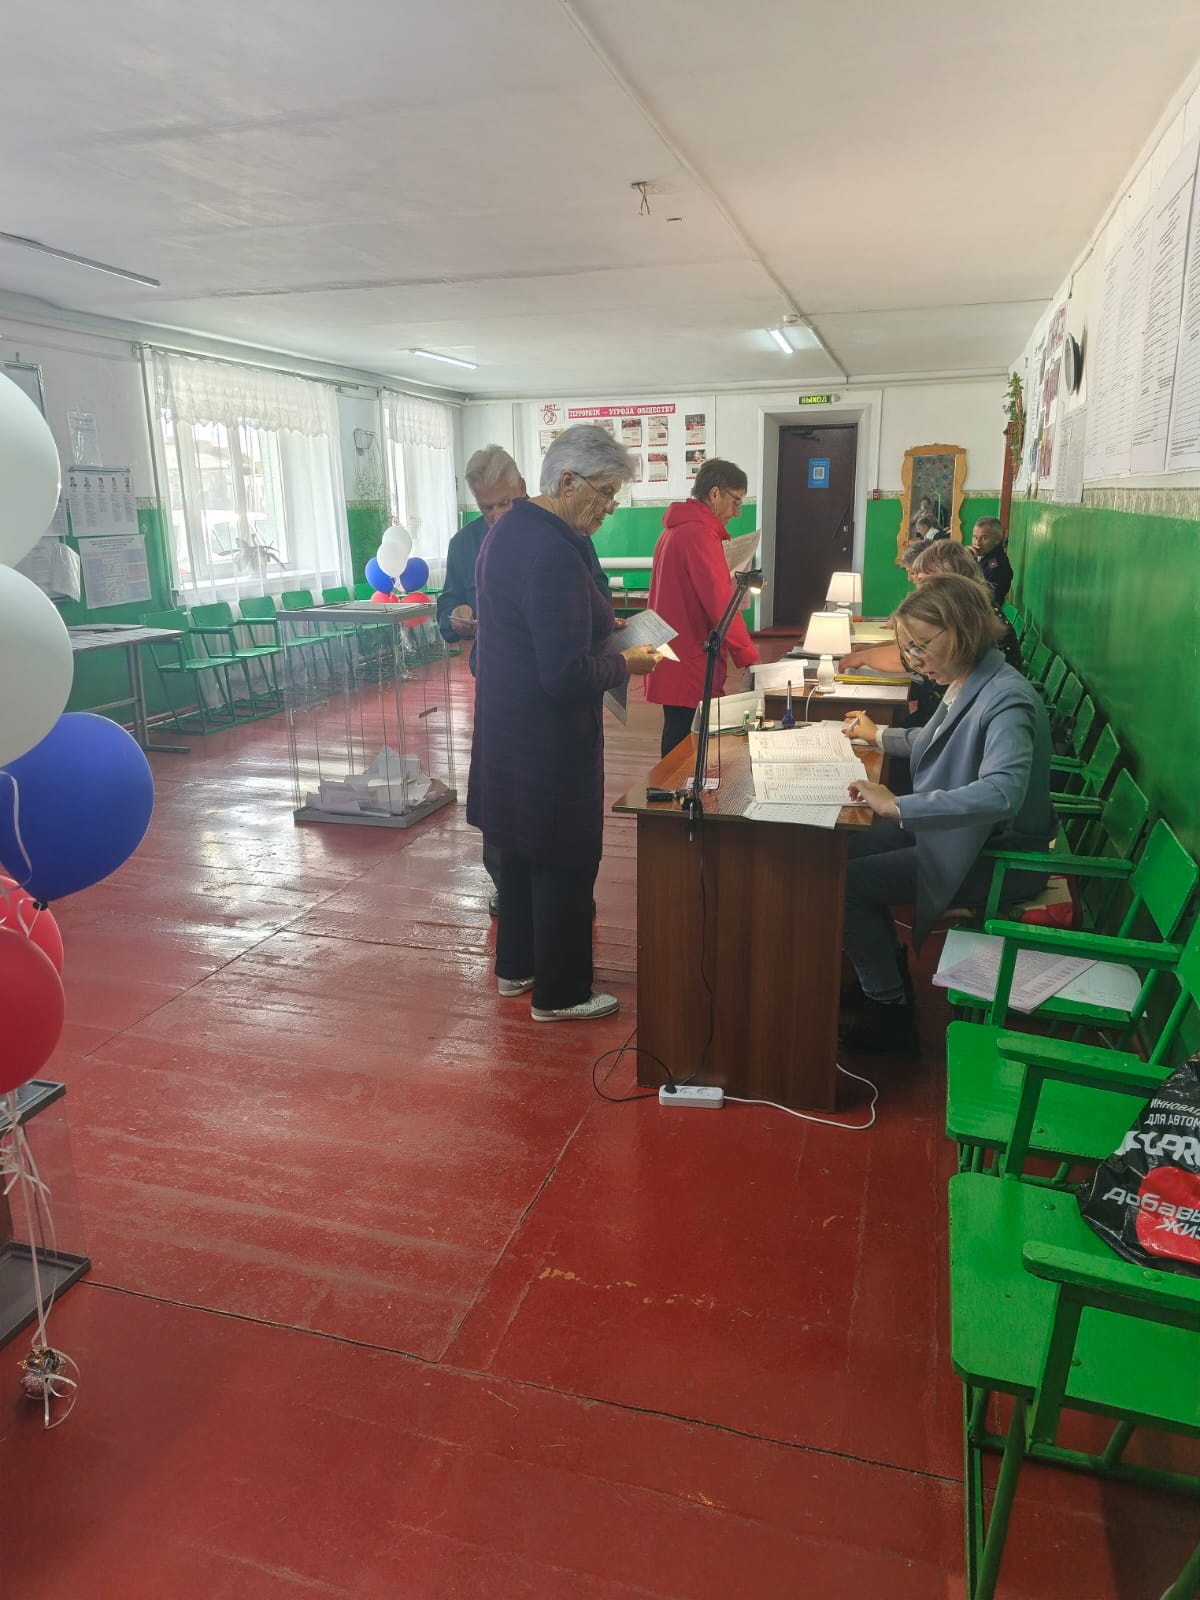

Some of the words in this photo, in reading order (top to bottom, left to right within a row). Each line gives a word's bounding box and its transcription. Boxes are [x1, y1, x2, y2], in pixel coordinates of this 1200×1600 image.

[609, 406, 634, 416] УГРОЗА
[637, 405, 674, 414] ОБЩЕСТВУ
[1144, 1113, 1166, 1125] ДЛЯ
